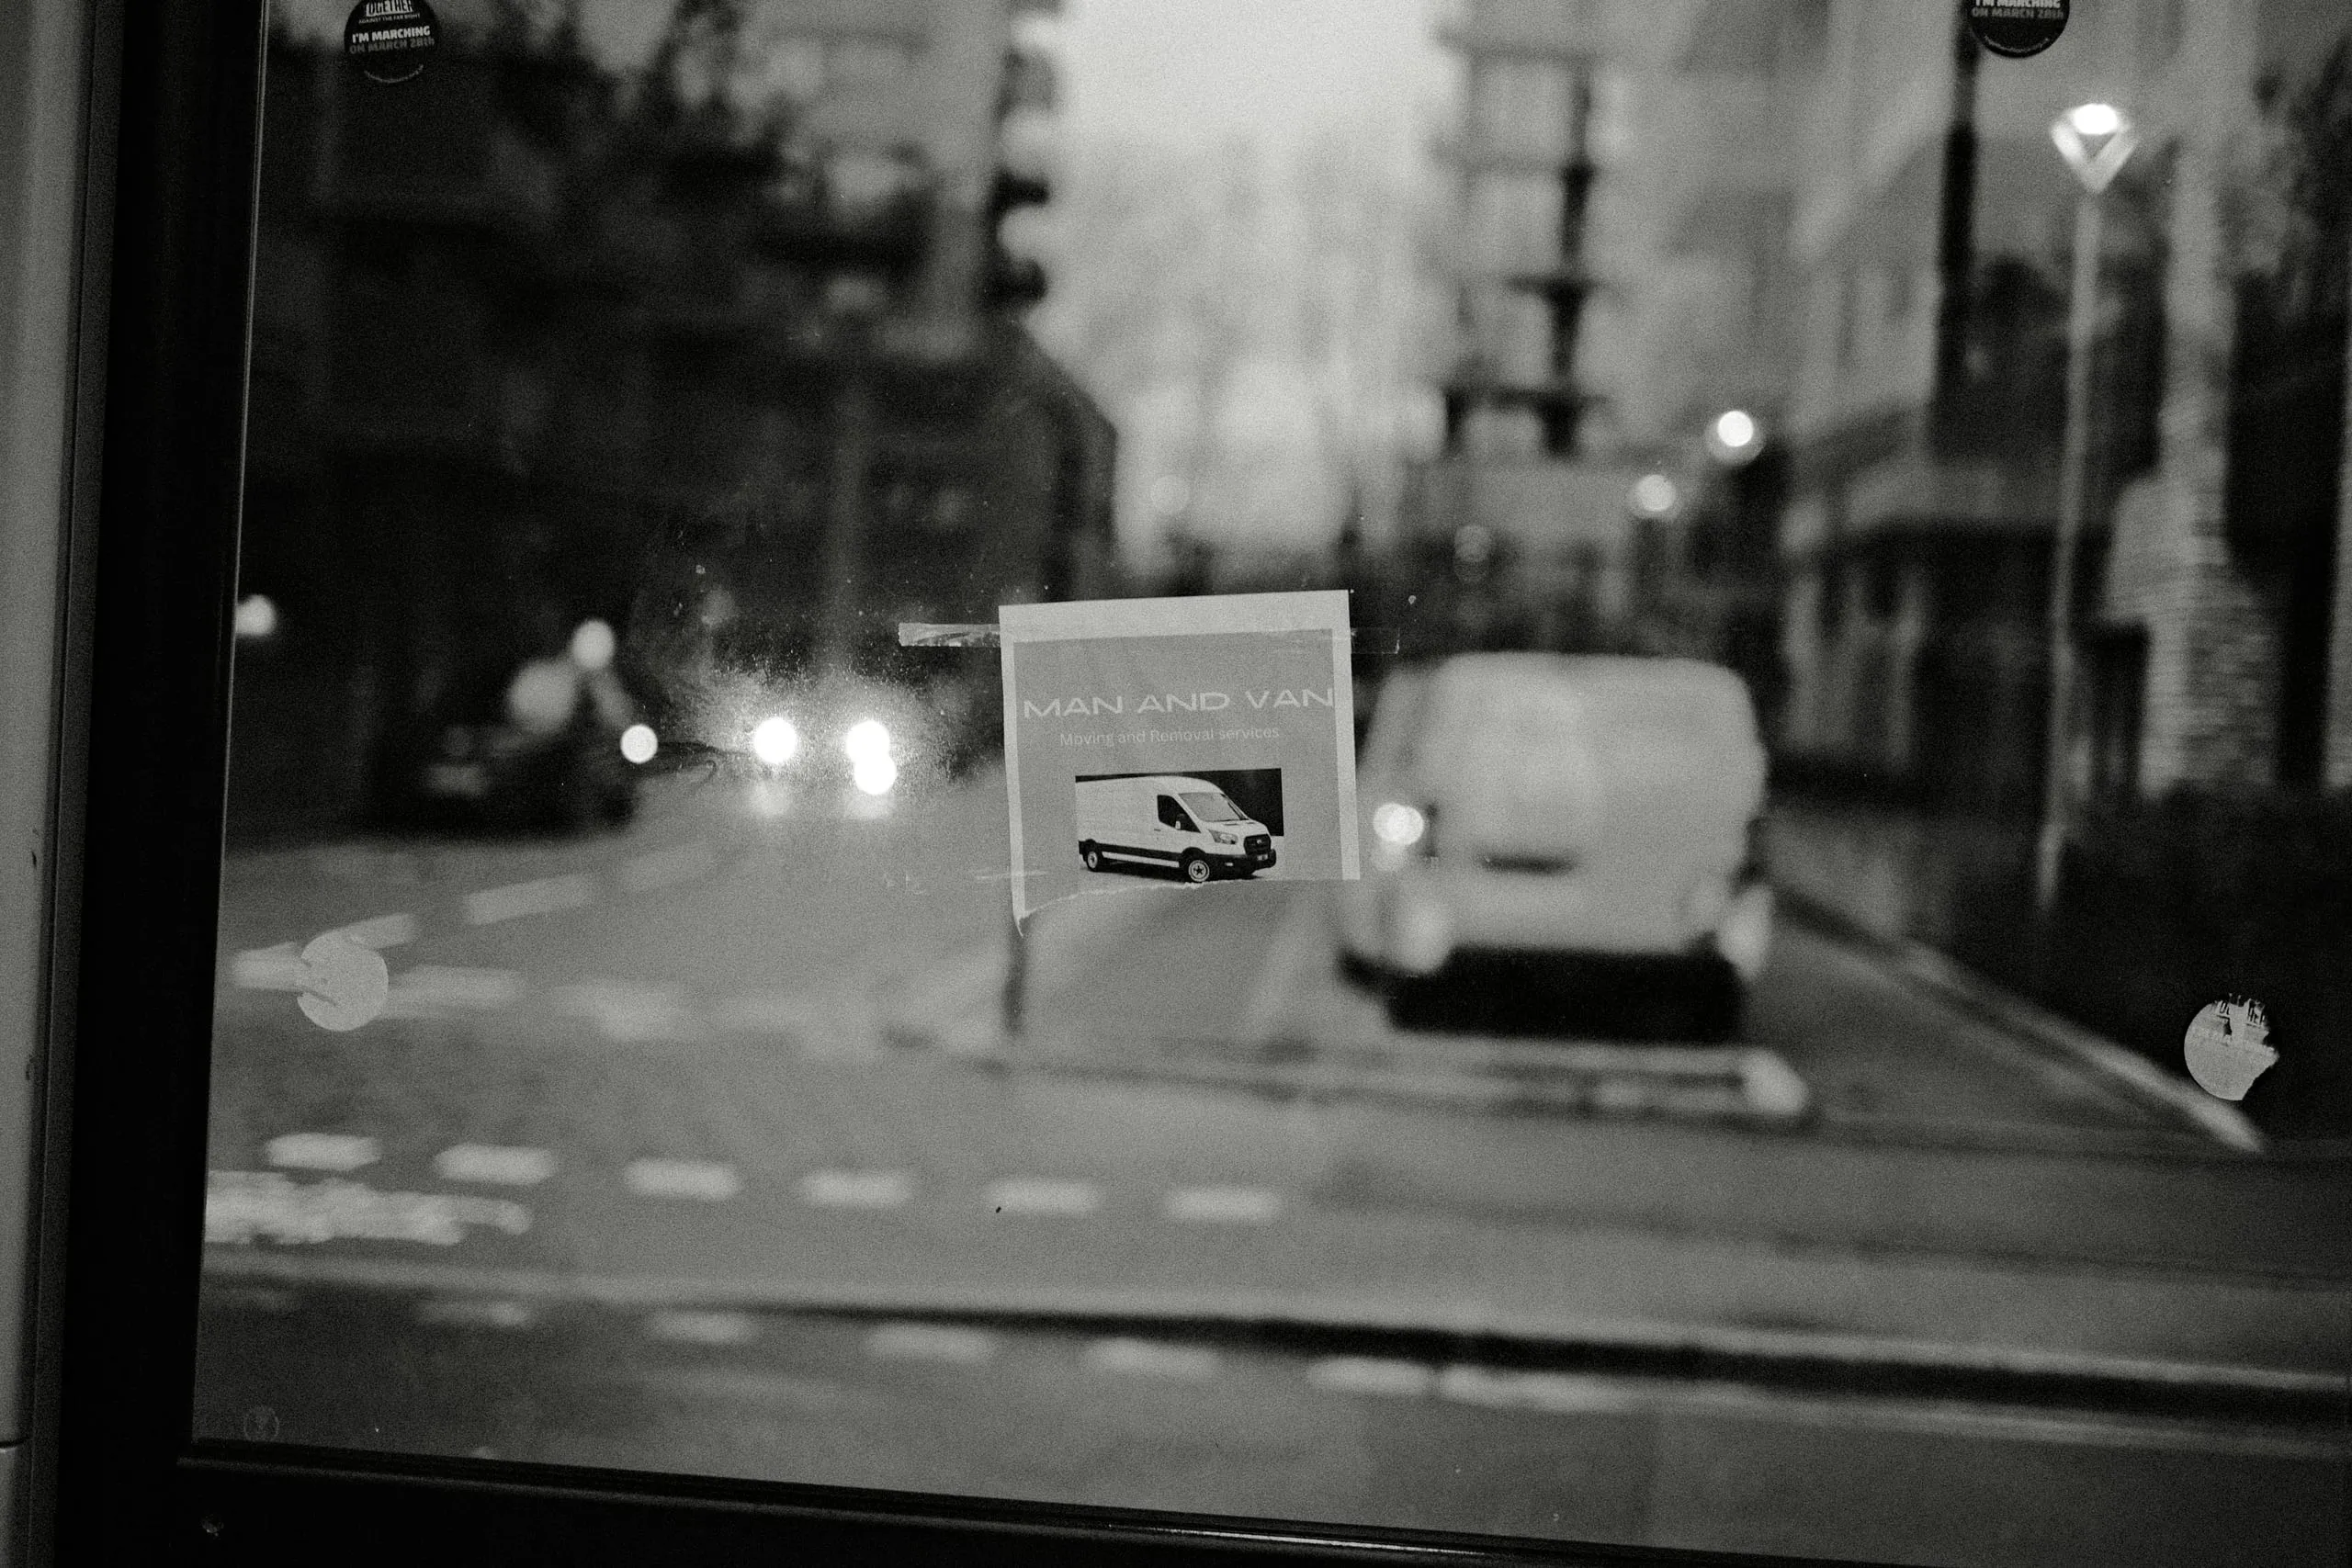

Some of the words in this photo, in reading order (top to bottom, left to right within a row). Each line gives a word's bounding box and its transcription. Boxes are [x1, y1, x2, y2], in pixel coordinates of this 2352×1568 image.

[1972, 7, 1989, 17] ON
[1991, 8, 2035, 18] MARCH
[352, 33, 369, 43] I'M
[371, 26, 431, 41] MARCHING
[349, 44, 366, 54] ON
[368, 39, 408, 52] MARCH
[410, 37, 435, 48] 28th
[1023, 695, 1123, 718] MAN
[1137, 691, 1231, 714] AND
[1245, 688, 1334, 709] VAN
[1060, 731, 1114, 747] Moving
[1116, 730, 1146, 743] and
[1150, 728, 1215, 743] Removal
[1219, 727, 1280, 740] services
